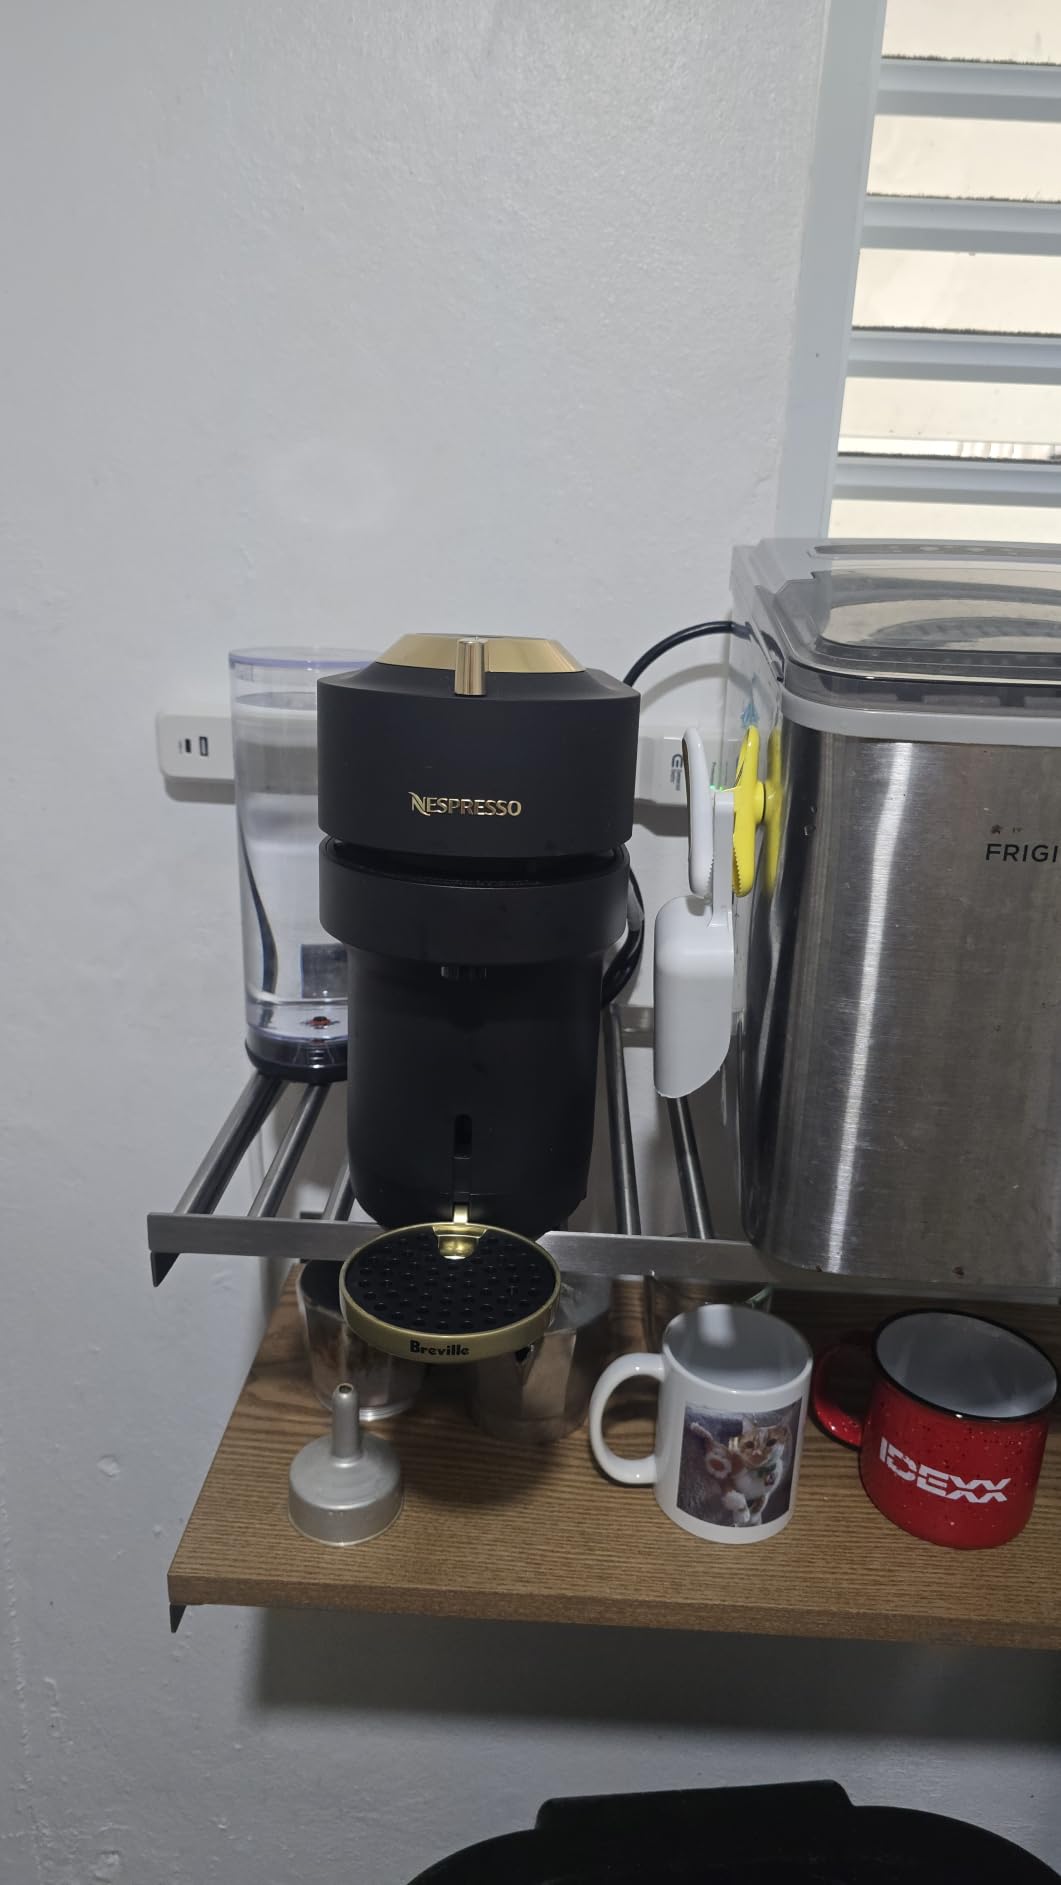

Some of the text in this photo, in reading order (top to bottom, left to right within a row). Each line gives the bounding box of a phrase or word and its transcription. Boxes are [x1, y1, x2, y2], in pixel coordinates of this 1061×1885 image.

[408, 791, 521, 816] NESPRESSO
[985, 843, 1059, 863] FRIGI
[410, 1340, 469, 1355] Breville
[880, 1436, 1011, 1503] IDEXX
